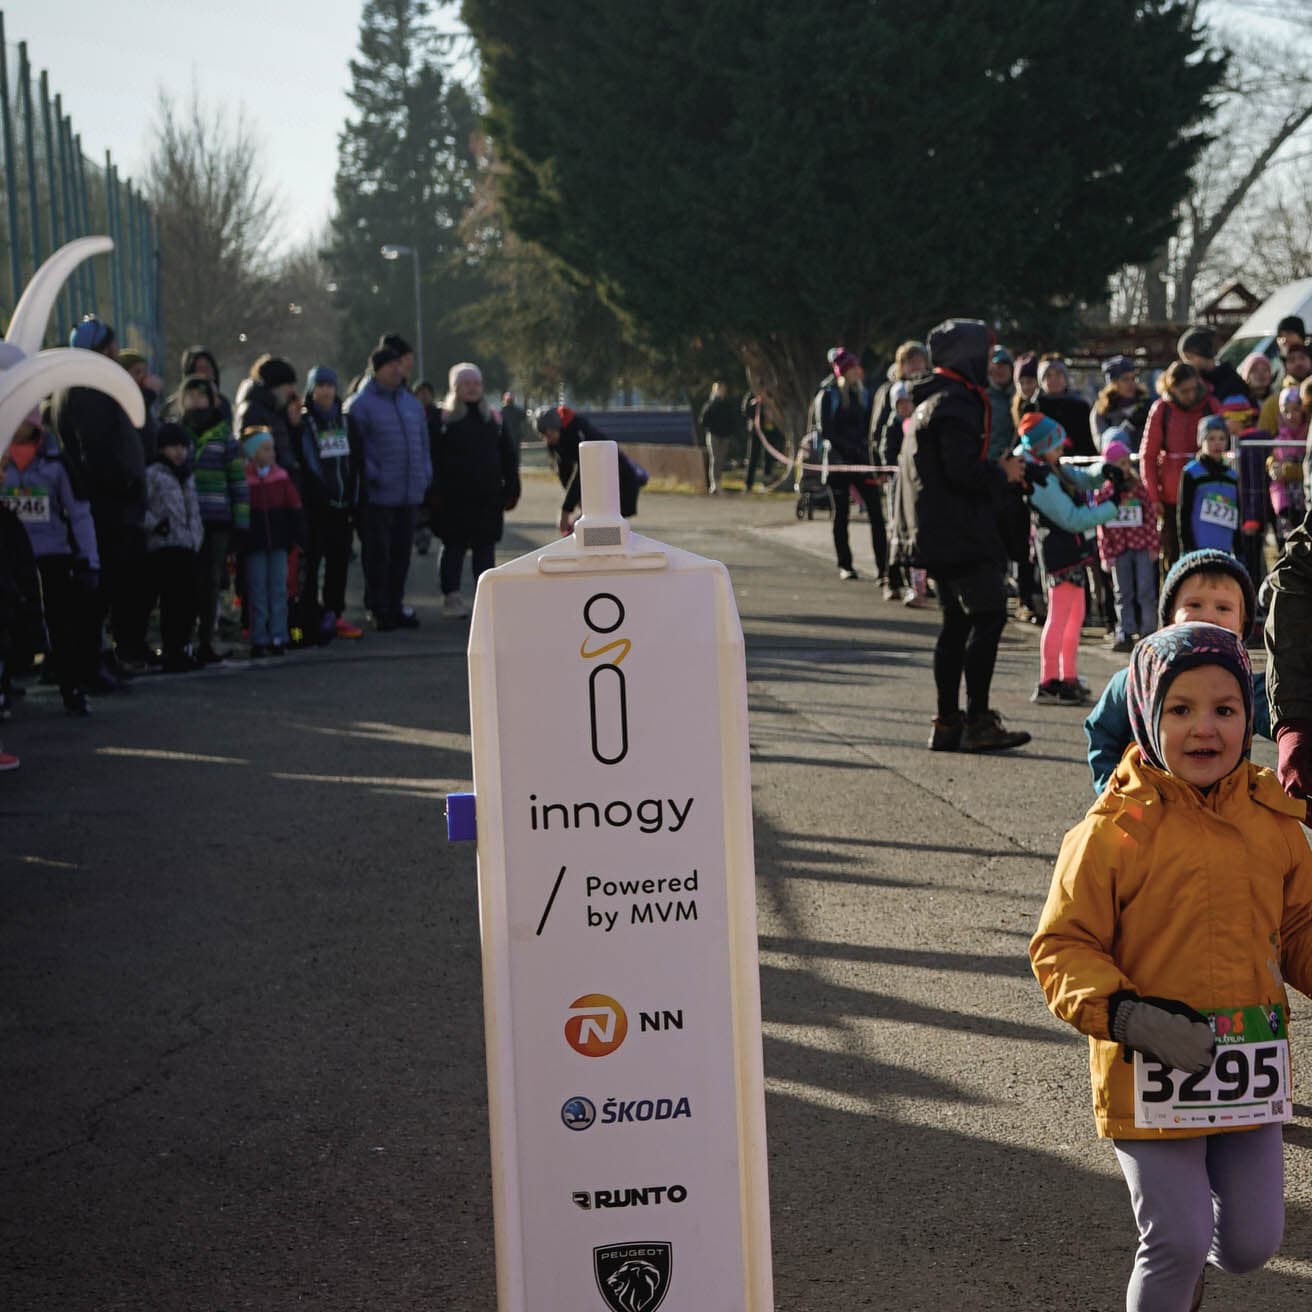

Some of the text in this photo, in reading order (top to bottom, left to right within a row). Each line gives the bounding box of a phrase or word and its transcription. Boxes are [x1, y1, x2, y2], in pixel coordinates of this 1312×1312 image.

[530, 794, 694, 833] innogy
[586, 869, 698, 897] Powered
[587, 900, 698, 933] by MVM
[639, 1009, 683, 1032] NN
[1142, 1046, 1280, 1103] 3295
[601, 1097, 692, 1124] ŠKODA
[594, 1184, 688, 1209] RUNTO
[600, 1247, 665, 1261] PEUGEOT
